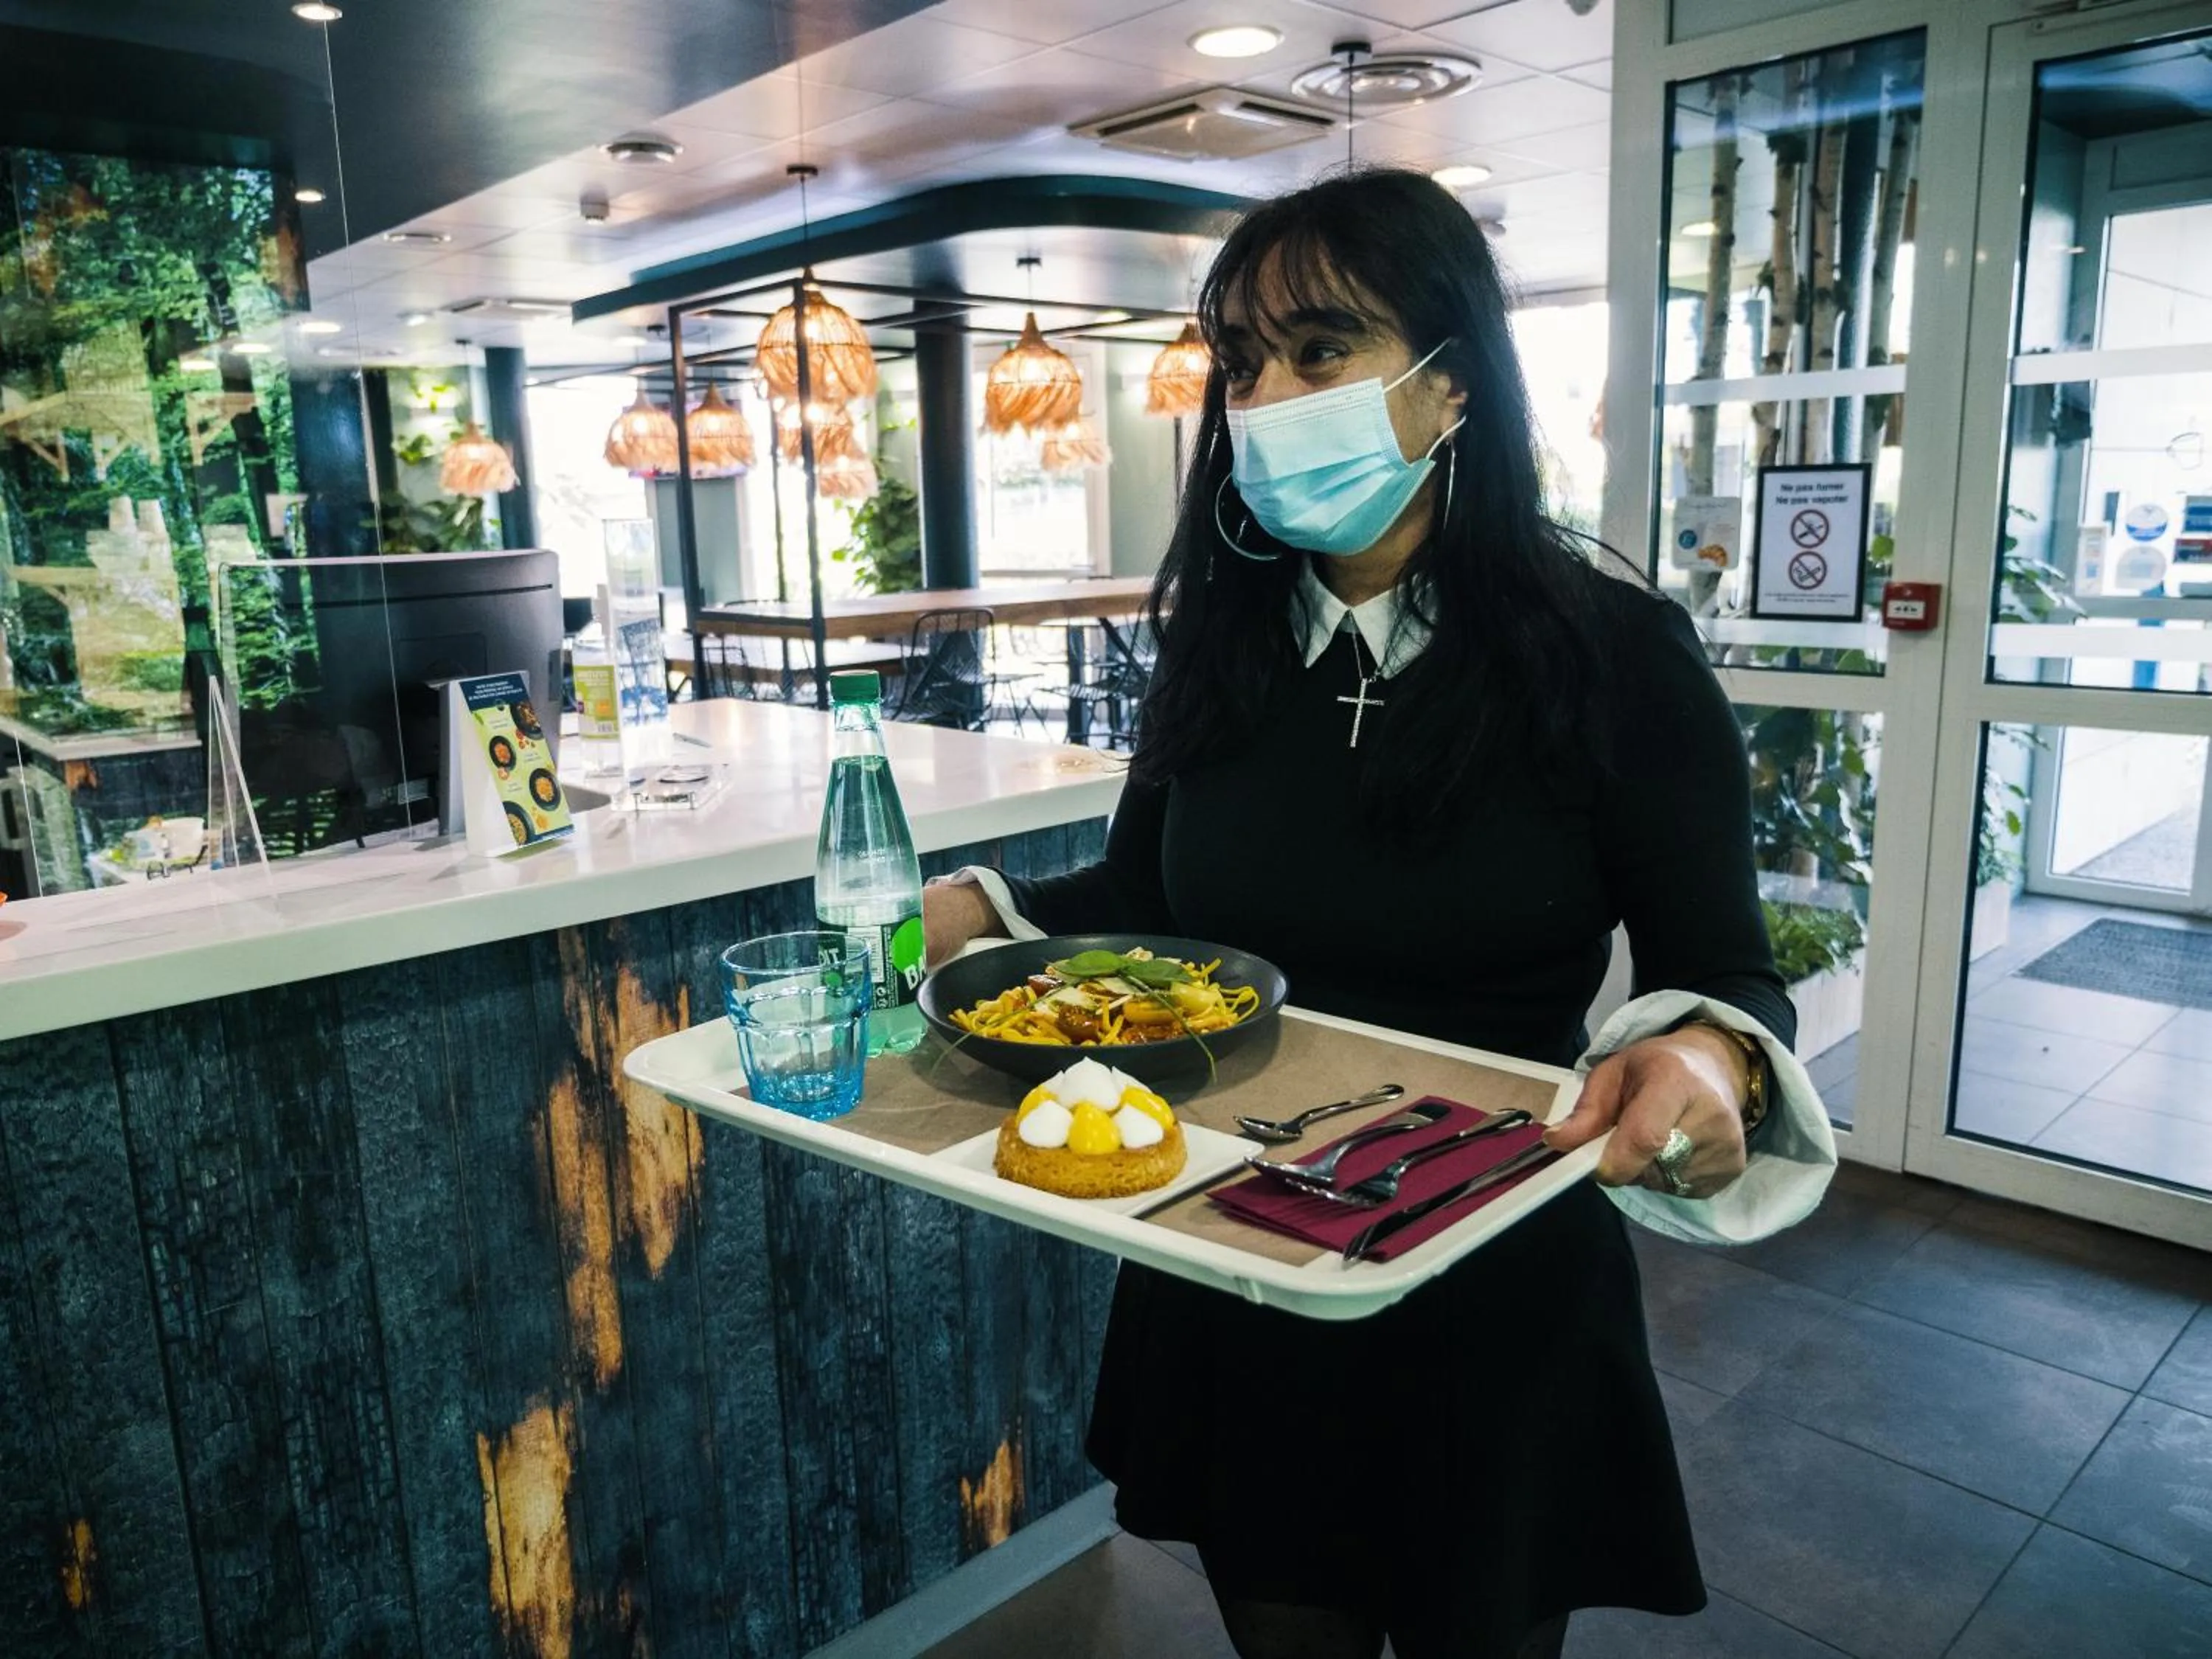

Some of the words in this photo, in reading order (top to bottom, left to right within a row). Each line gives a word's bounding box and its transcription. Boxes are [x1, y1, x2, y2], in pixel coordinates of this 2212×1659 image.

[1795, 484, 1813, 493] pas
[1816, 483, 1844, 491] fumer
[1775, 495, 1788, 504] Ne
[1812, 495, 1848, 504] vapoter
